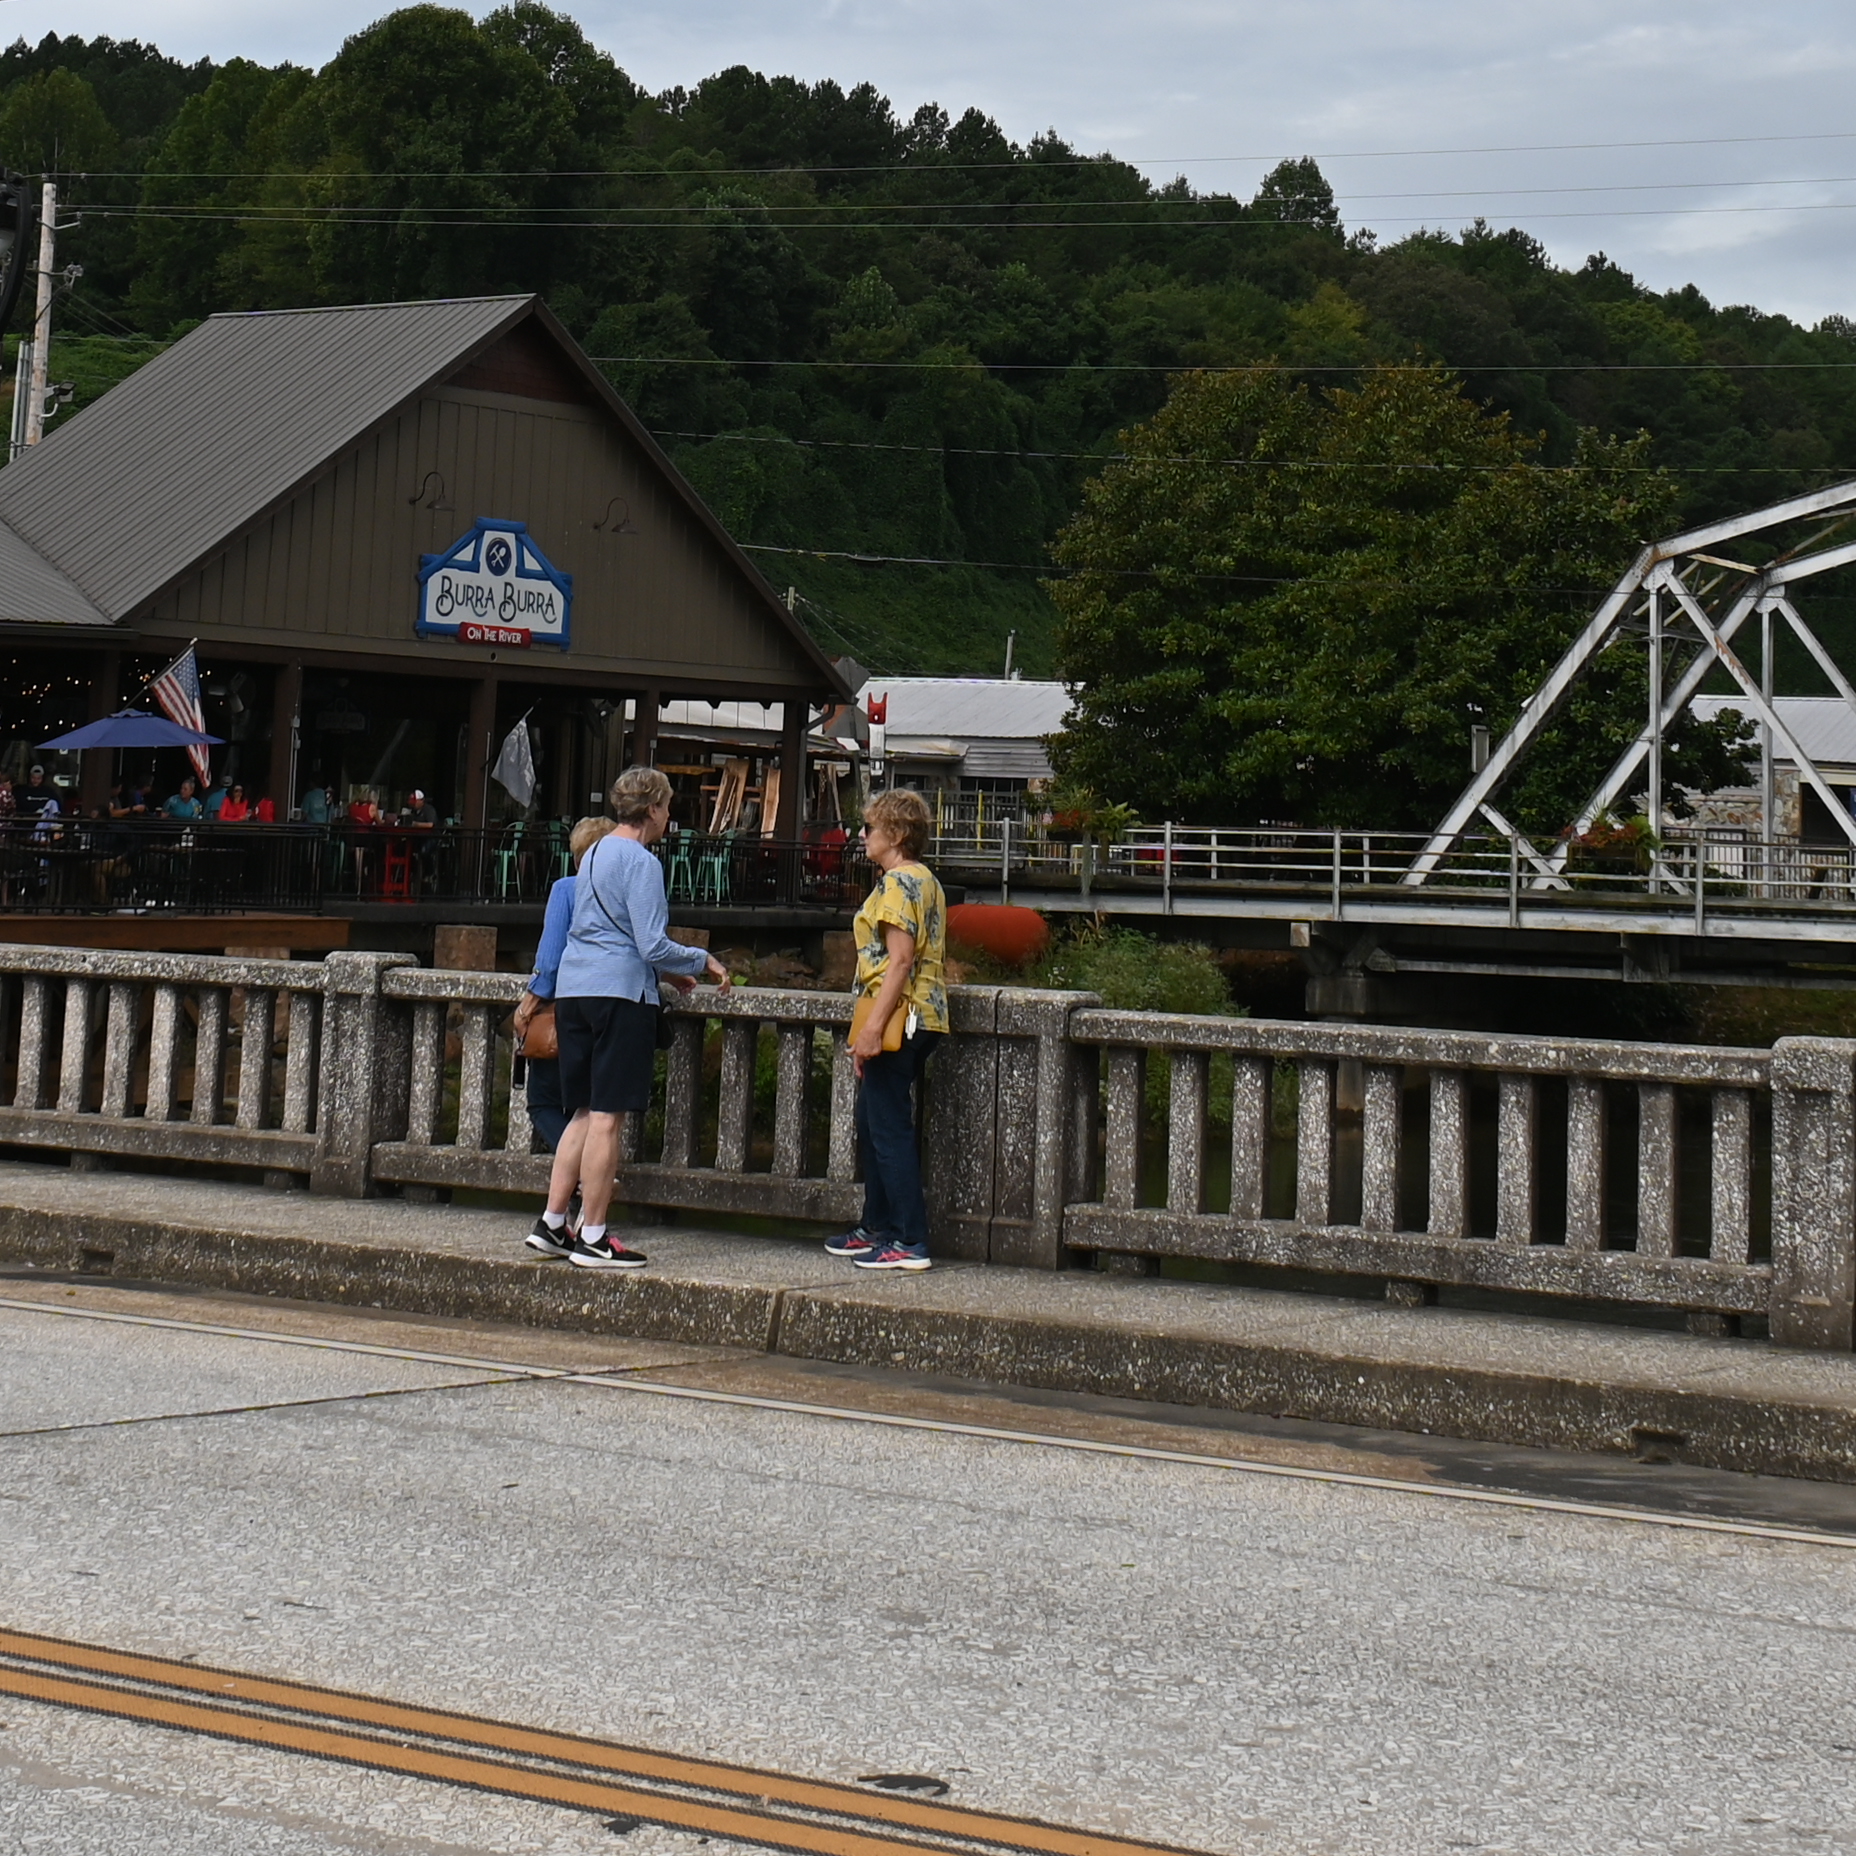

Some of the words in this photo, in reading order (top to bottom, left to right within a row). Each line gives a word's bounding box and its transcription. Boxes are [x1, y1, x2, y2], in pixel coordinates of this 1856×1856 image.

[436, 575, 495, 617] BURRA
[498, 582, 557, 624] BURRA
[466, 627, 482, 640] ON
[482, 625, 497, 642] THE
[498, 631, 522, 644] RIVER
